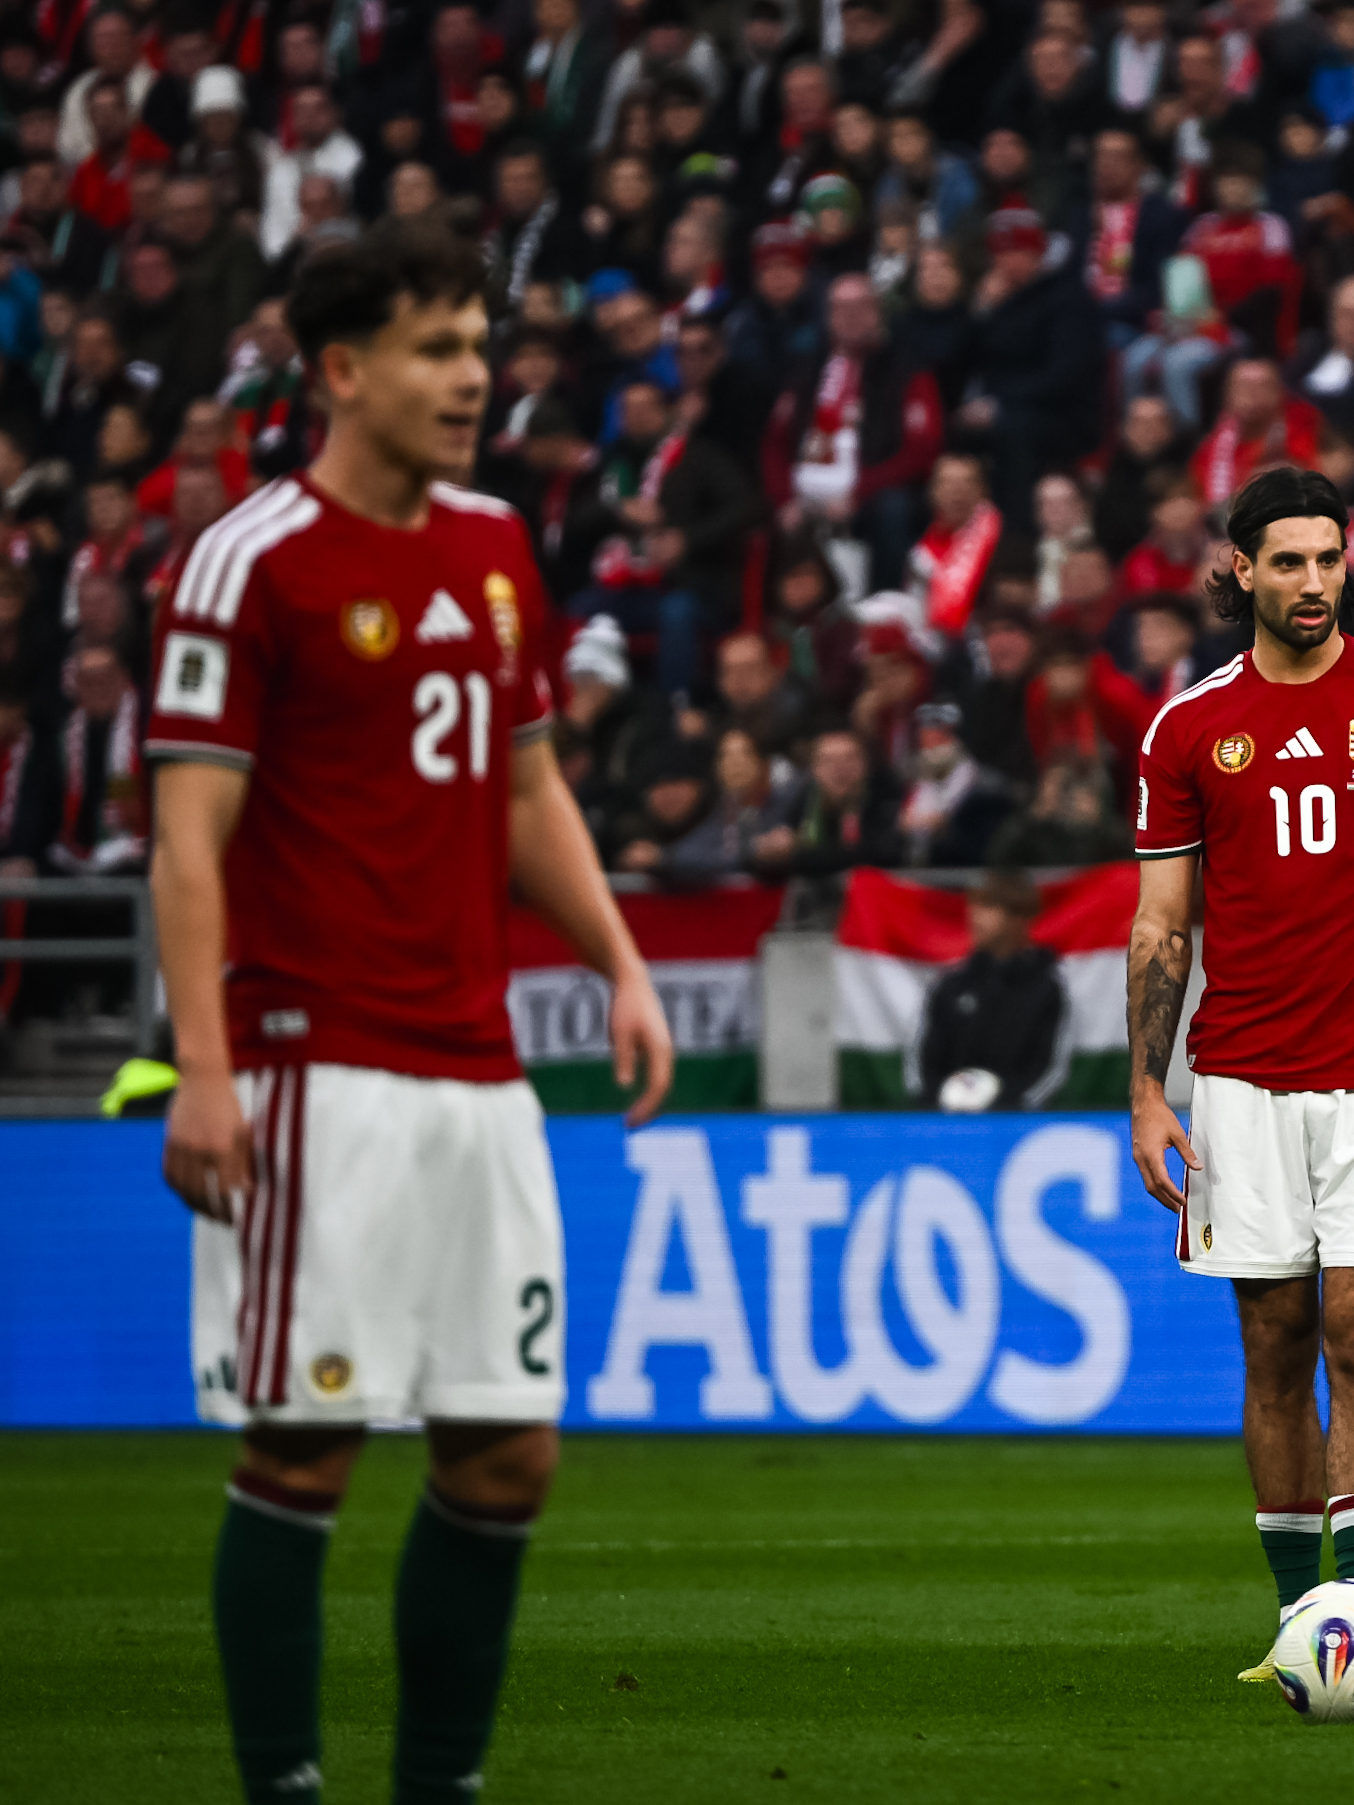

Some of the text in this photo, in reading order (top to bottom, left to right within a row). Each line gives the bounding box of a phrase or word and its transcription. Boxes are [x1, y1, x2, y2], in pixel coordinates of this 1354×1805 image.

[412, 671, 492, 784] 21
[1269, 784, 1337, 857] 10
[519, 1278, 554, 1376] 2
